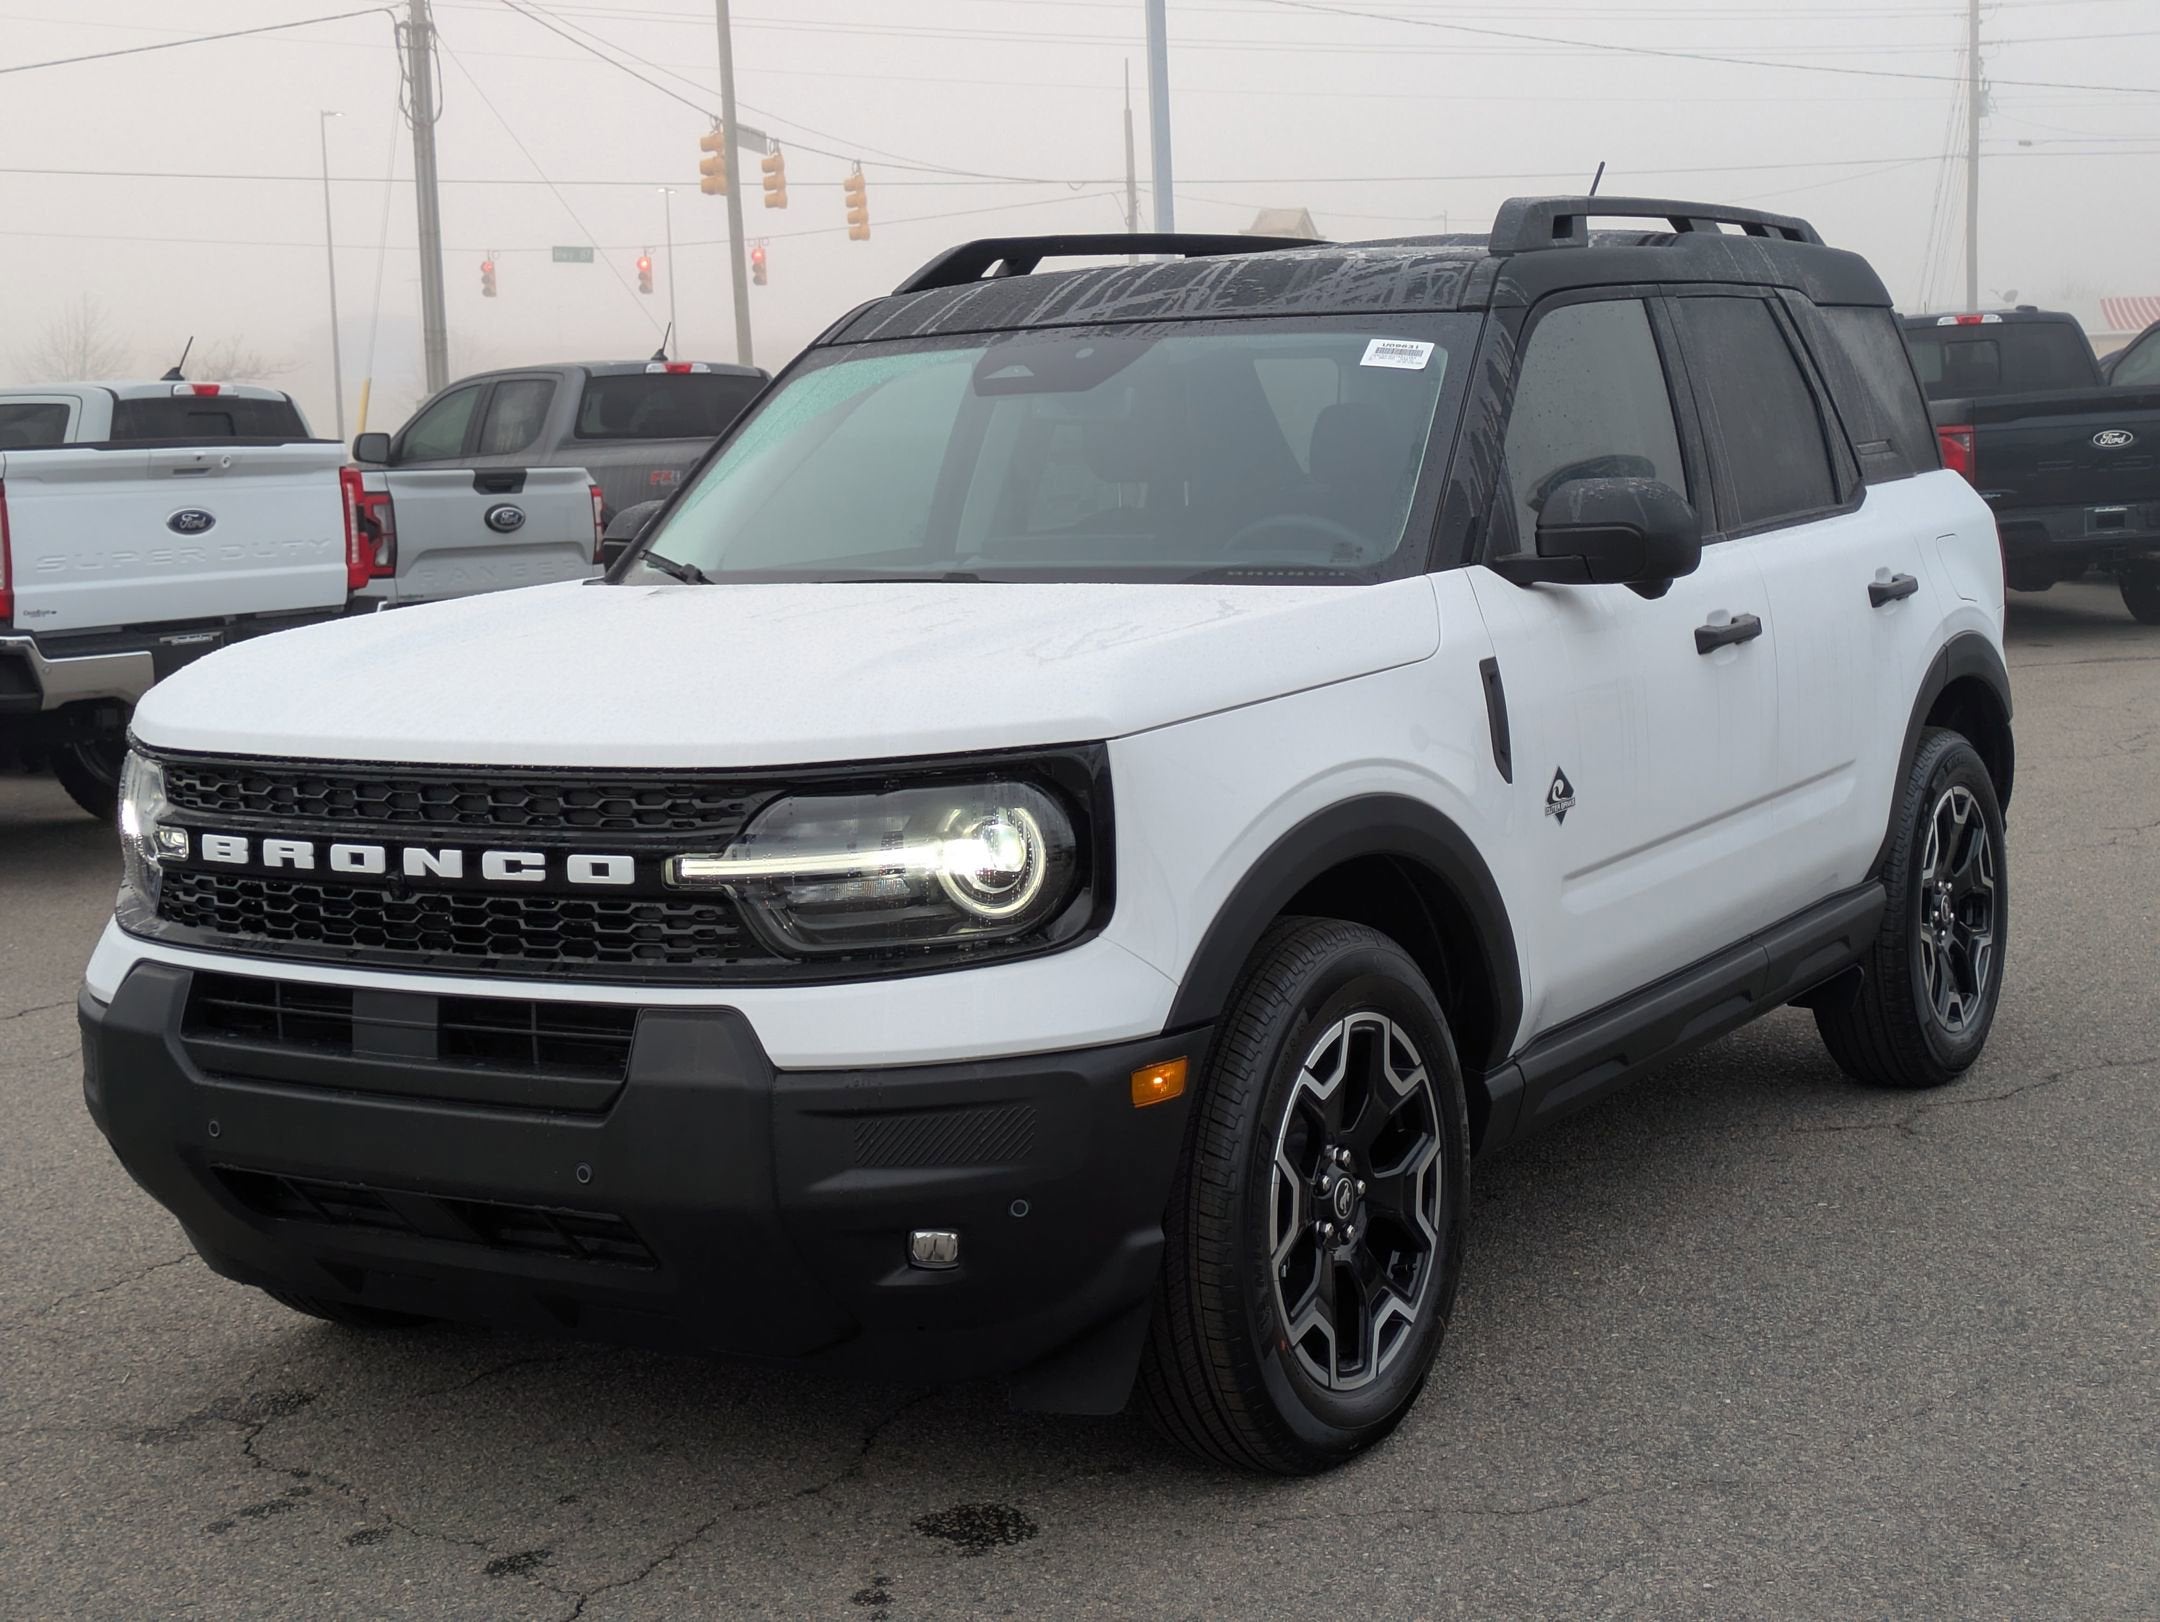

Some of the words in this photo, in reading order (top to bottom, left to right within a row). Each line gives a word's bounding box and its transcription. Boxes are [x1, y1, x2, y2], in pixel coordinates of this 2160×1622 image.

[2100, 433, 2126, 445] Ford
[179, 512, 207, 529] Ford
[499, 511, 519, 525] Ford
[36, 547, 207, 573] SUPER
[216, 538, 331, 561] DUTY
[201, 833, 635, 885] BRONCO
